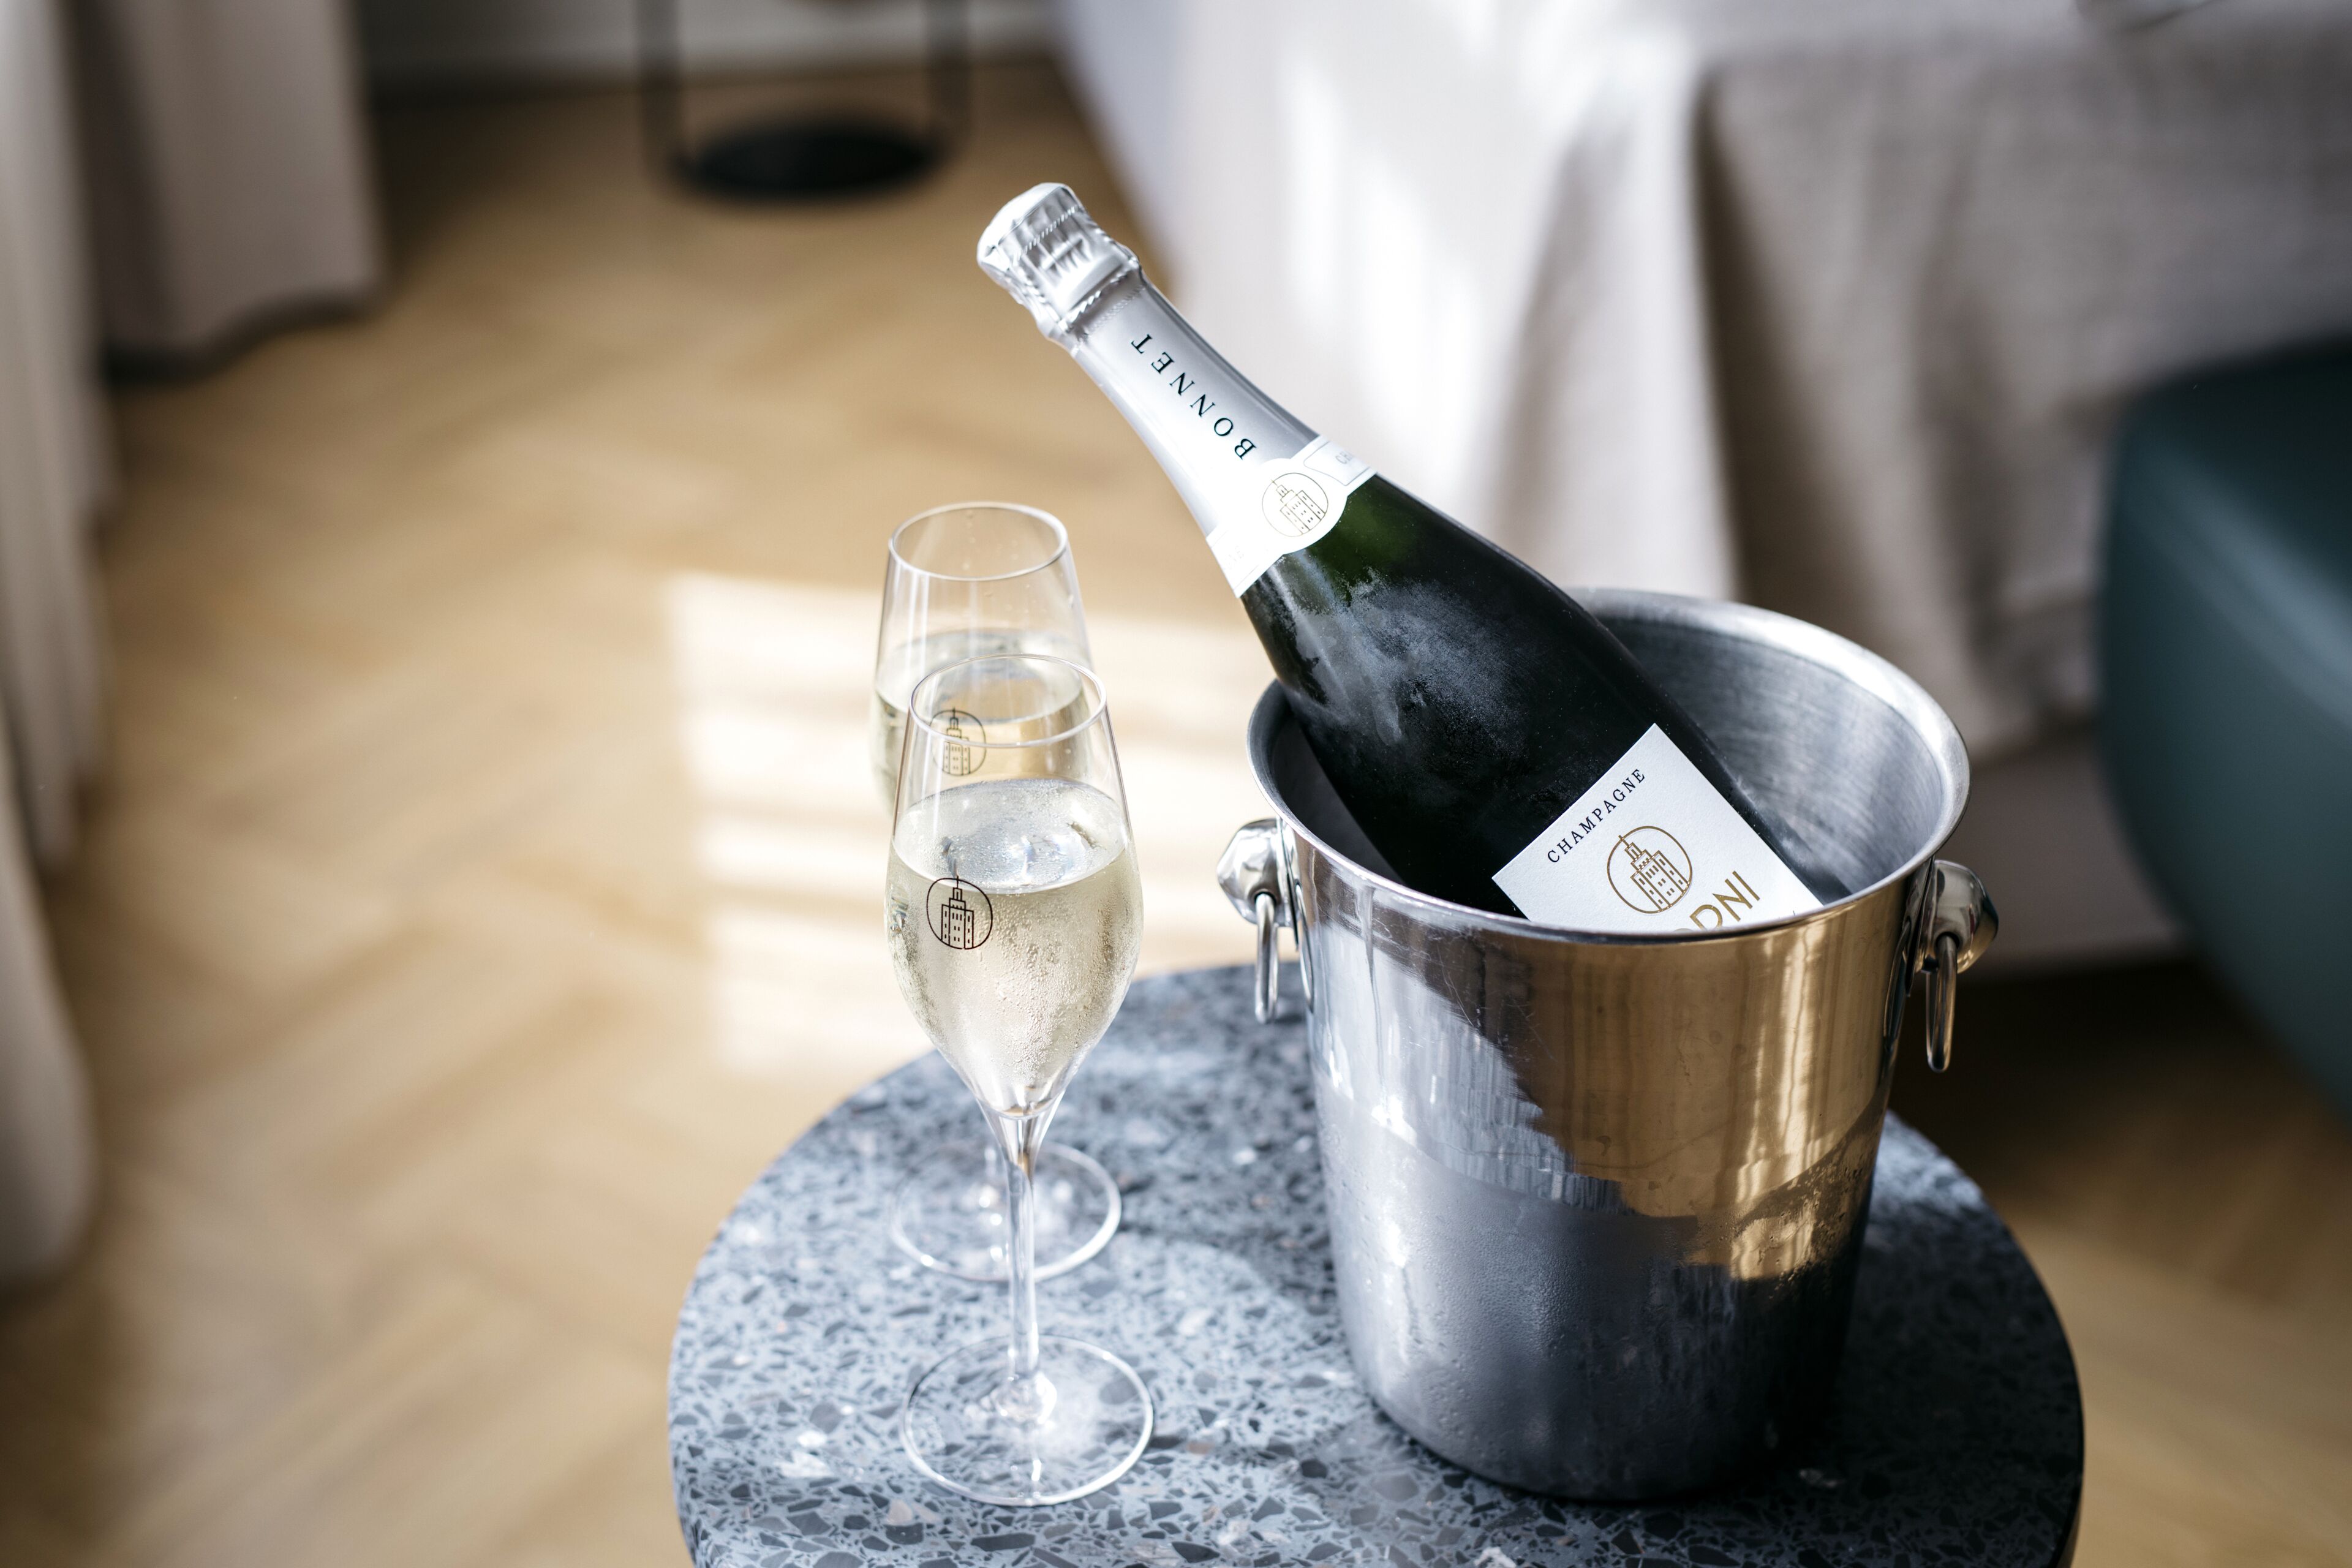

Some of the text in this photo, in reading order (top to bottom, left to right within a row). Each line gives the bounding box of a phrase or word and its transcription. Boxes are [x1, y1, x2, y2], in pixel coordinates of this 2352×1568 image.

[1131, 334, 1257, 460] BONNET
[1547, 768, 1646, 864] CHAMPAGNE
[1673, 870, 1761, 933] DNI
